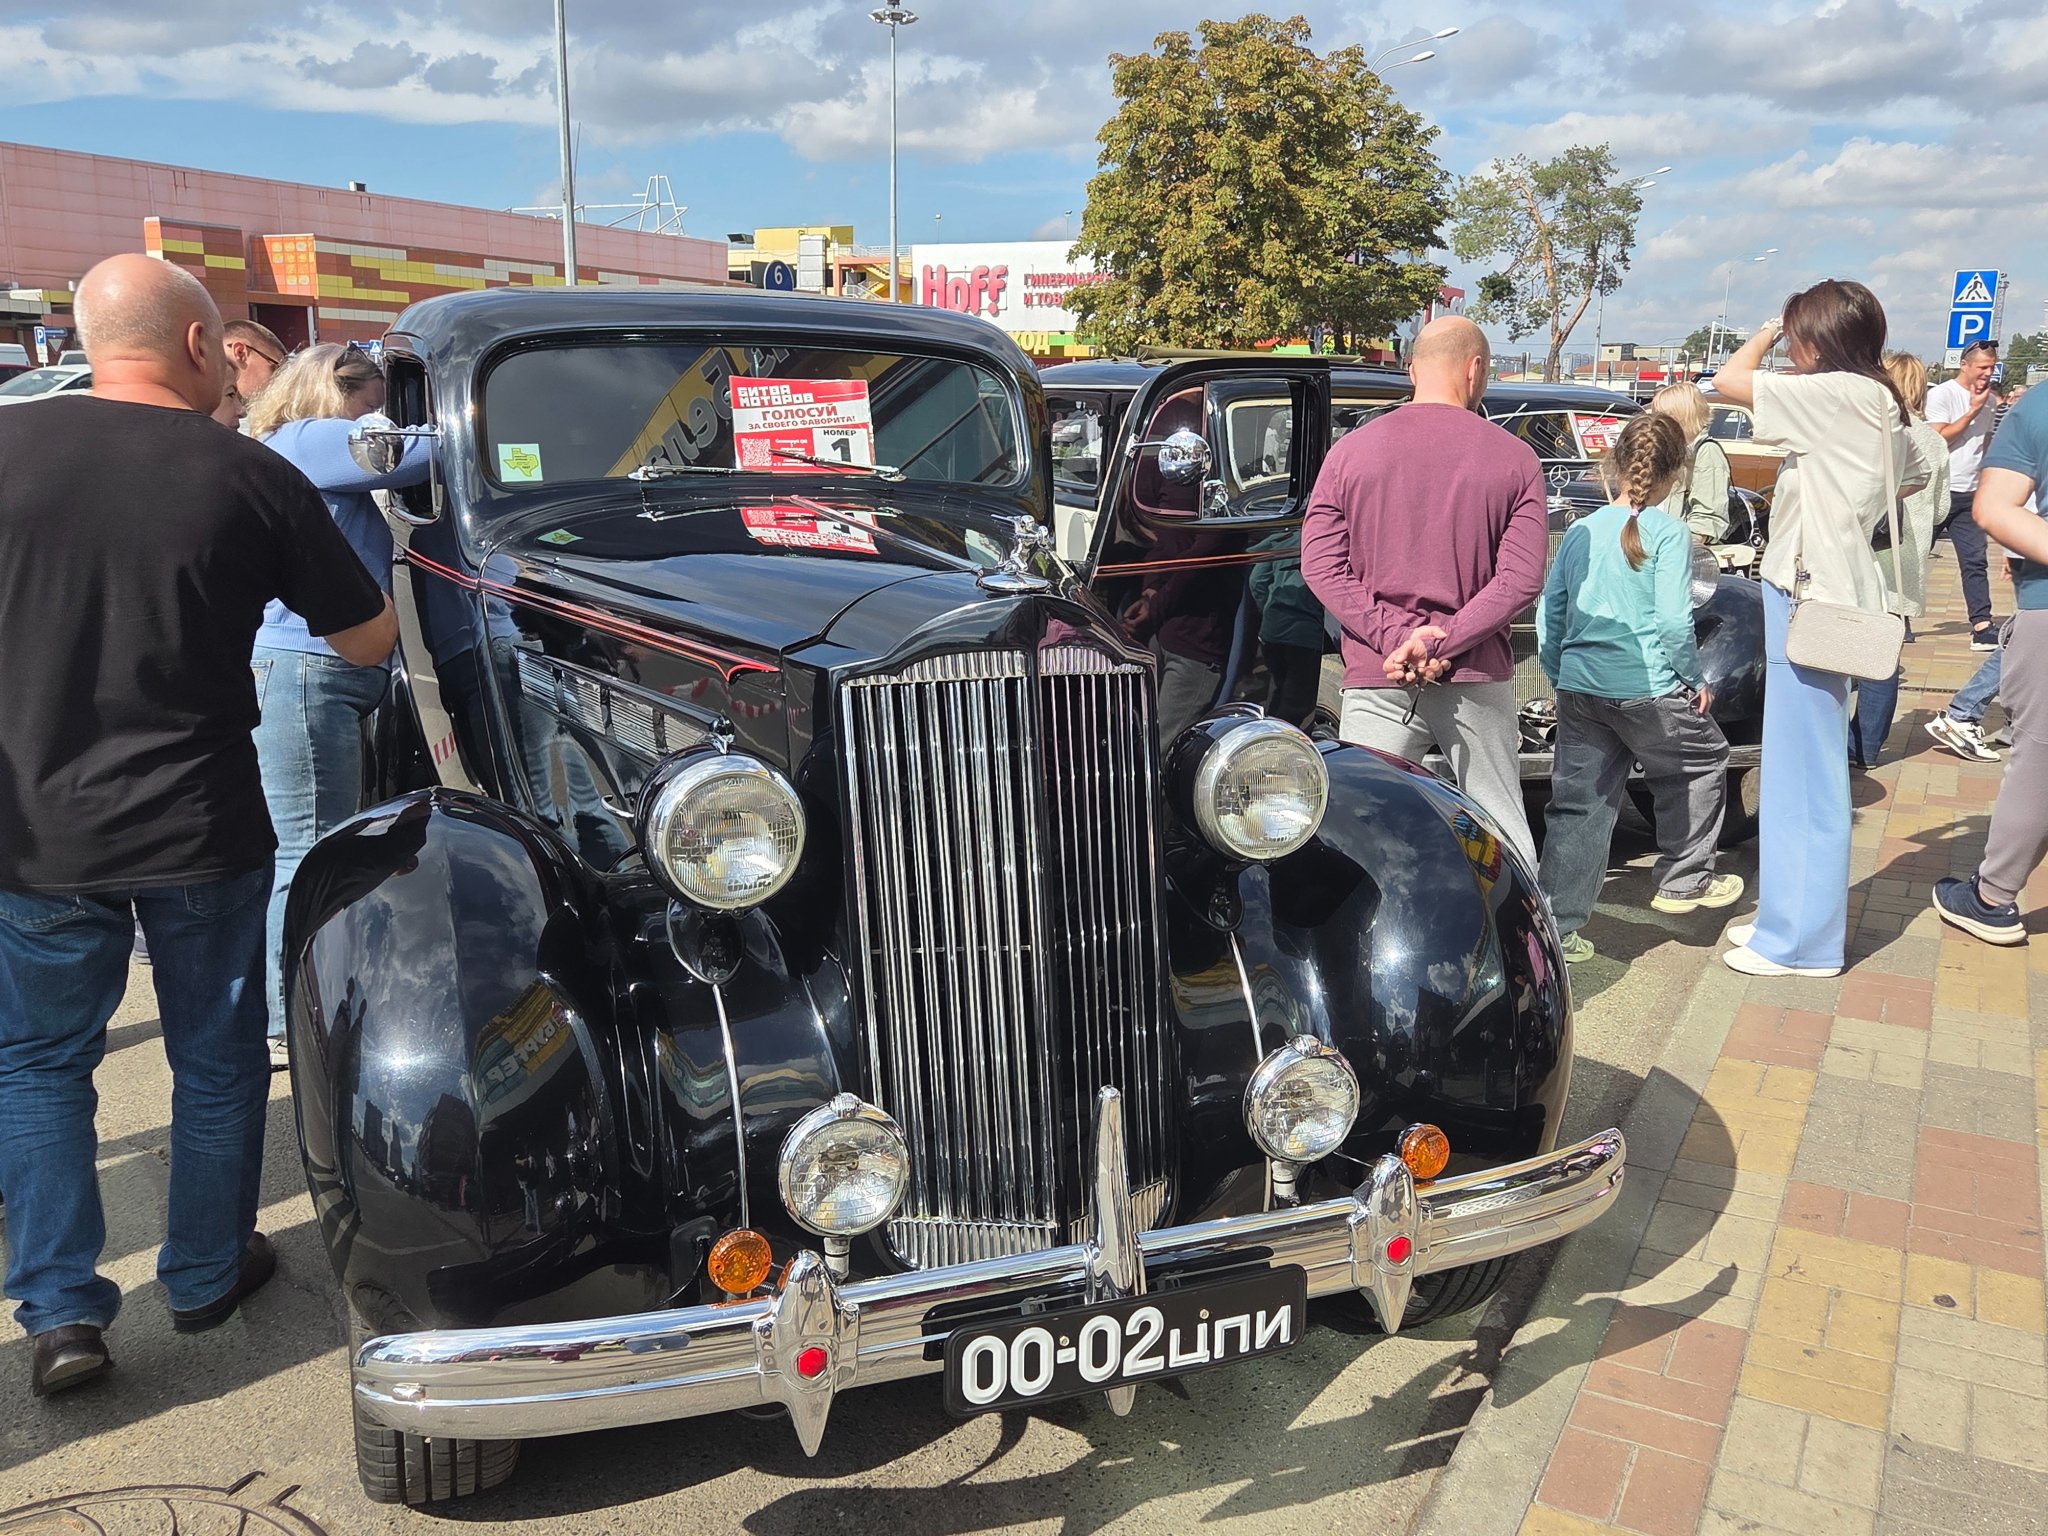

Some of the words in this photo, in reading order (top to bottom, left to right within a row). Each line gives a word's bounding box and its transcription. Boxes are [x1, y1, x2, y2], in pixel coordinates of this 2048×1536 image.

[774, 265, 783, 285] 6
[1024, 293, 1033, 305] И
[1037, 292, 1067, 306] ТОВ
[1958, 314, 1984, 344] P
[737, 385, 791, 397] БИТВА
[740, 393, 815, 407] МОТОРОВ
[762, 403, 838, 421] ГОЛОСУЙ
[763, 420, 798, 429] СВОЕГО
[800, 415, 856, 426] ФАВОРИТА!
[831, 438, 852, 463] 1
